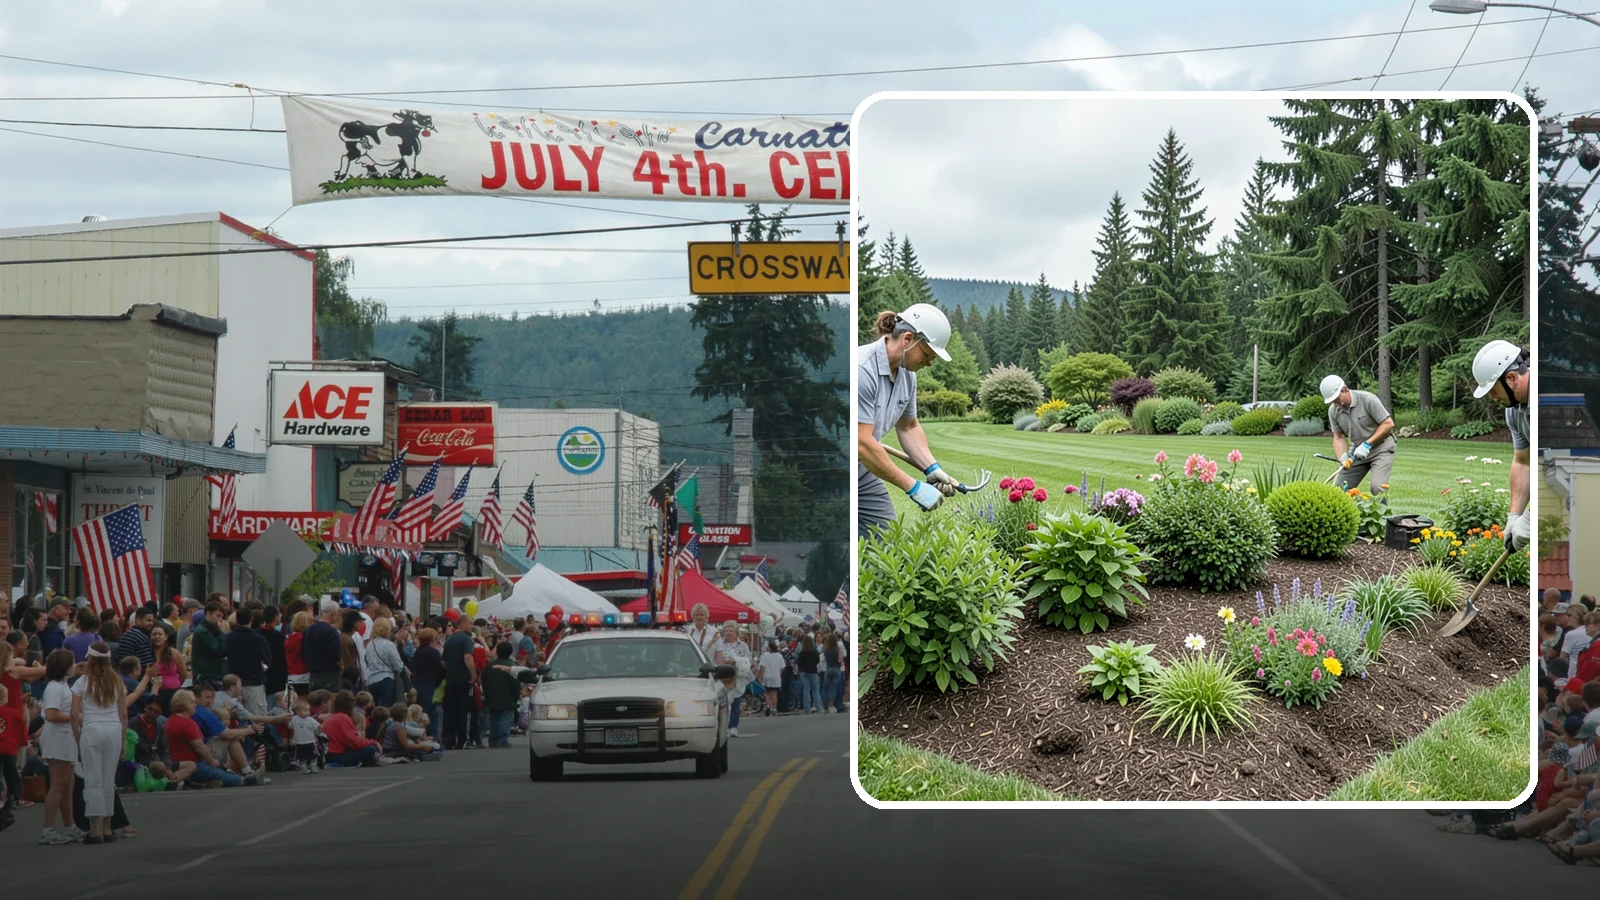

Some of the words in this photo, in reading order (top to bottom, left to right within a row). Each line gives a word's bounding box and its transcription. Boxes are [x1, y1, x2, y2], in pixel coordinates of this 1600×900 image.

[481, 141, 604, 192] JULY
[632, 150, 746, 198] 4th.
[697, 254, 850, 280] CROSSWA
[283, 380, 373, 420] ACE
[405, 409, 452, 422] CEDAR
[283, 421, 370, 436] Hardware
[416, 428, 477, 447] Coca-Cola
[353, 467, 387, 480] Simpl
[83, 485, 93, 494] St.
[96, 485, 124, 494] Vincent
[126, 486, 135, 494] de
[138, 486, 155, 495] Paul
[81, 503, 154, 521] THT
[688, 526, 741, 535] CRNATION
[699, 535, 730, 543] GLASS
